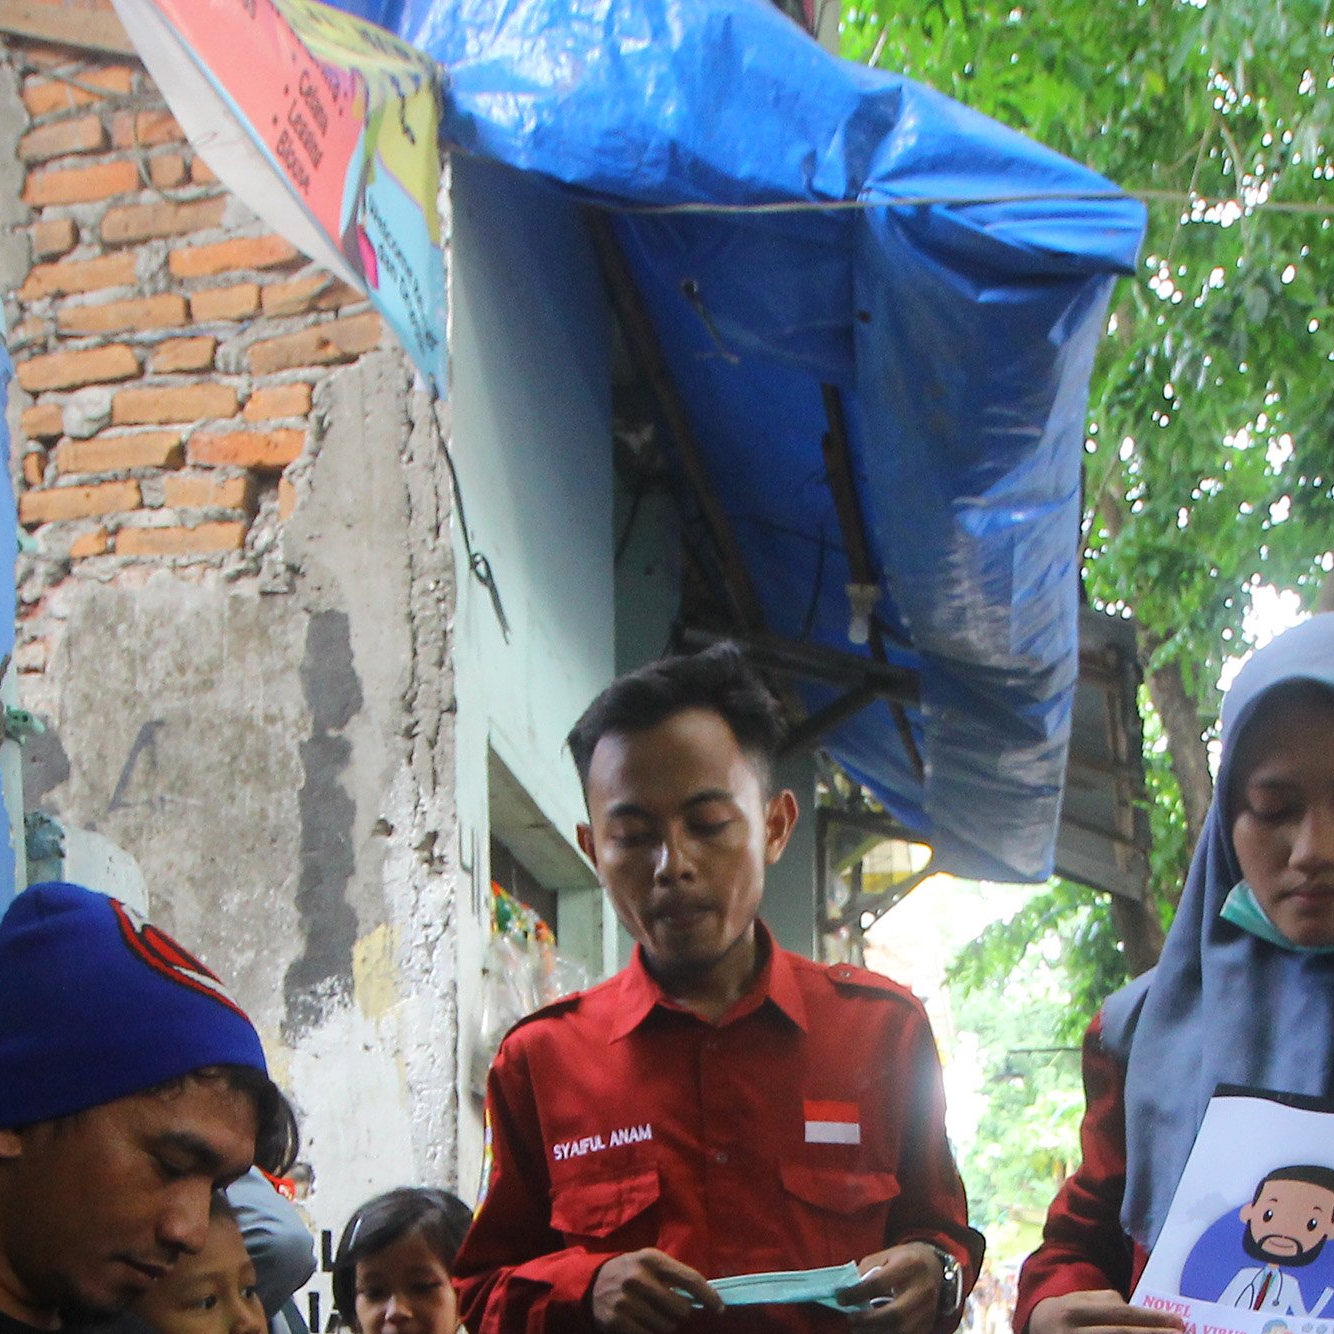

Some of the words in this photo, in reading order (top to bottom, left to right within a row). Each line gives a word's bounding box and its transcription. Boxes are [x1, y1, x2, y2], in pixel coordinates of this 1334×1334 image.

[553, 1134, 606, 1160] SYAIFUL
[609, 1123, 653, 1147] ANAM
[1142, 1295, 1191, 1318] NOVEL
